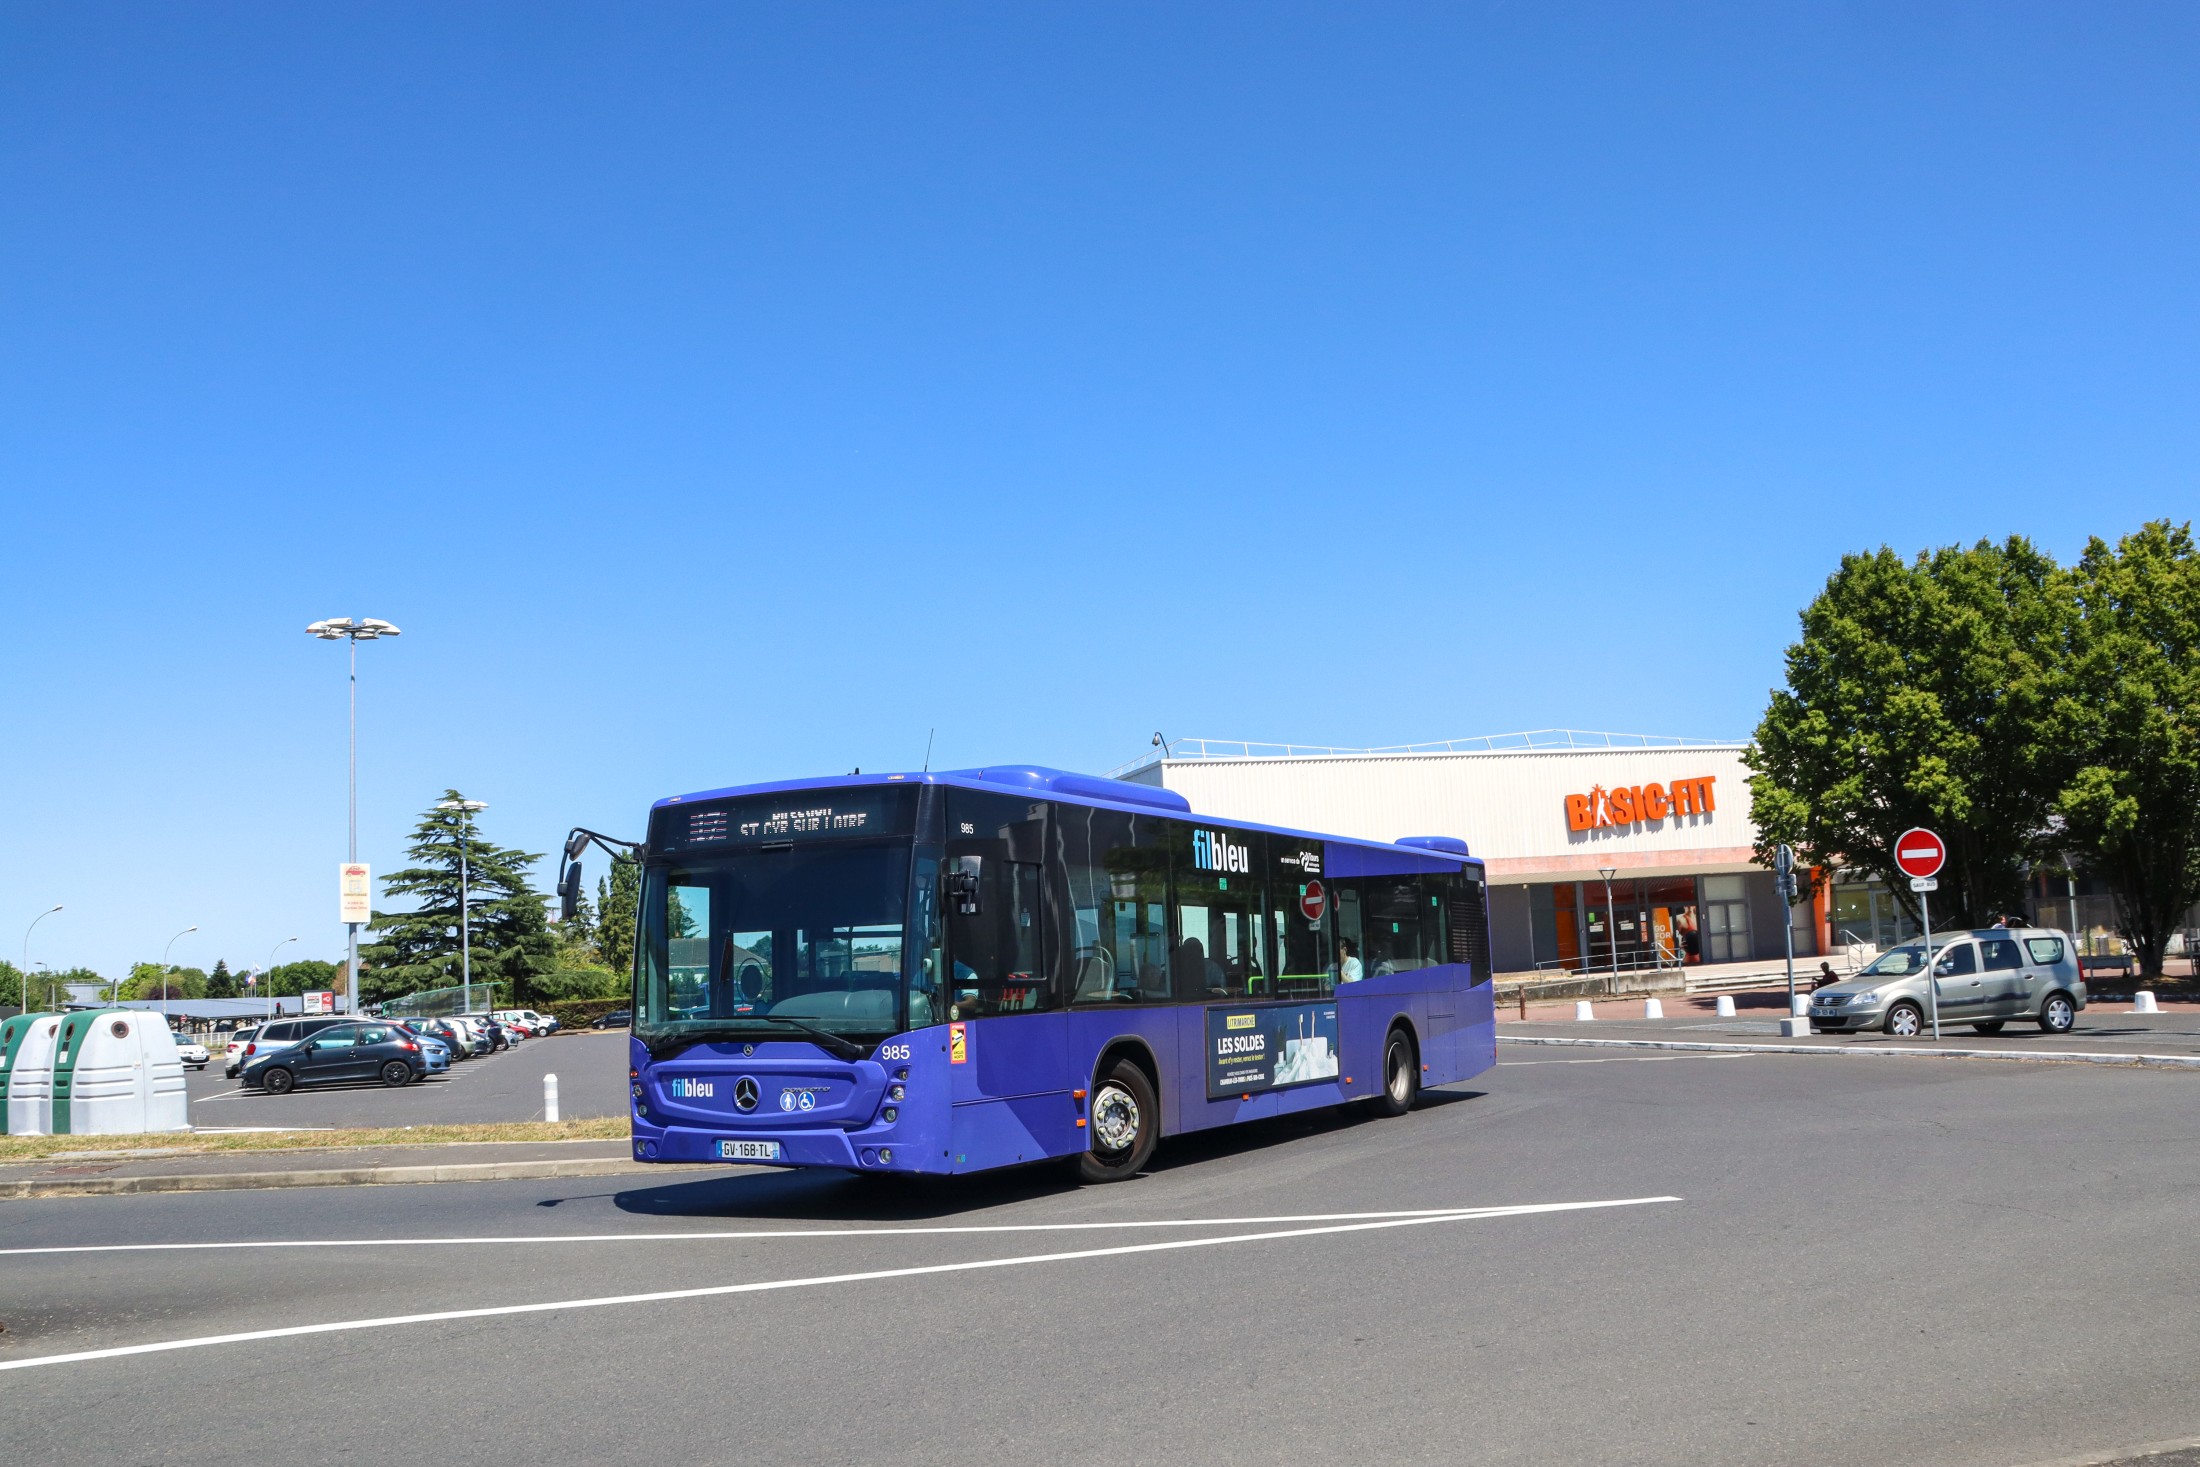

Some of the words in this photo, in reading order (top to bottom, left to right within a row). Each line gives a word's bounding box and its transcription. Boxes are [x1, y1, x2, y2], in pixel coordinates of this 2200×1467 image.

[1566, 776, 1716, 831] BASIC-FIT
[960, 822, 974, 835] 985
[1192, 829, 1249, 874] filbleu
[1654, 924, 1666, 932] GO
[882, 1045, 910, 1060] 985
[1217, 1037, 1233, 1055] LES
[1234, 1034, 1265, 1053] SOLDES
[671, 1078, 714, 1098] filbleu
